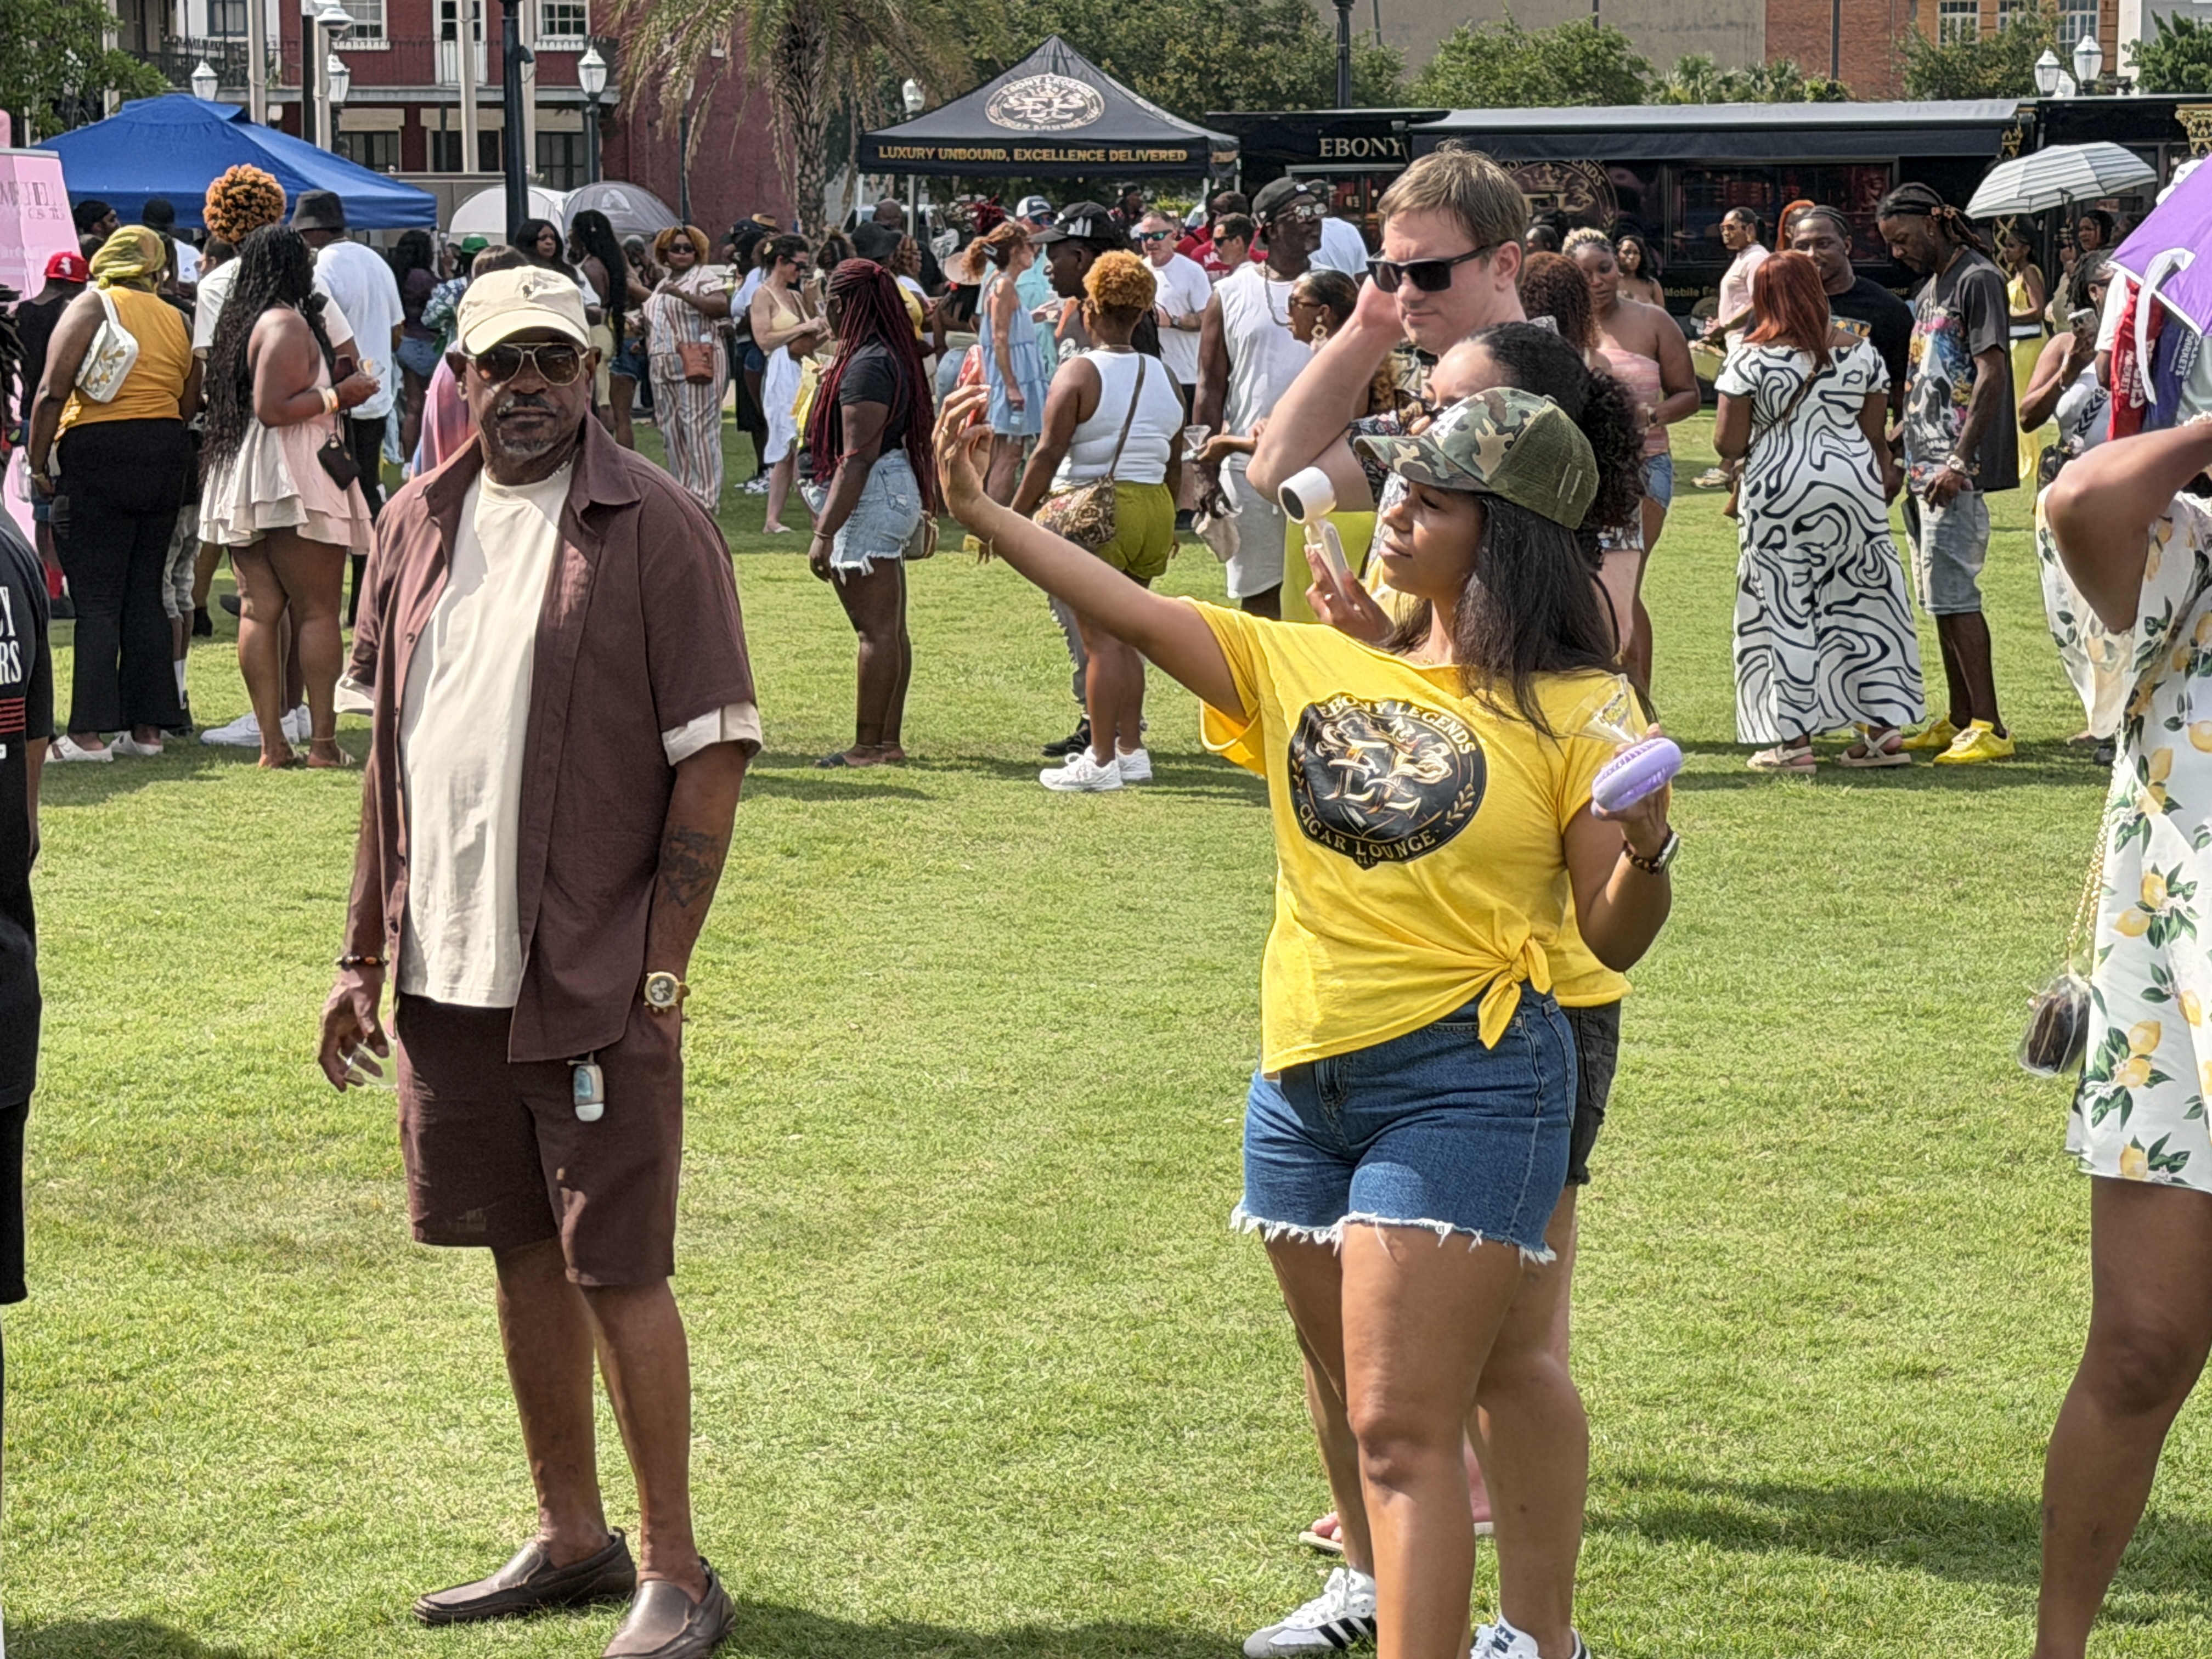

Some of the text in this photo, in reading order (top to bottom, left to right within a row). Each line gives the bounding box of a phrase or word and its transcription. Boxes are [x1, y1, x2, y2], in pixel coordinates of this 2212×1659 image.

[879, 146, 1187, 162] LUXURY UNBOUND, EXCELLENCE DELIVERED
[1319, 138, 1401, 157] EBONY
[1319, 695, 1476, 754] EBONY LEGENDS
[1300, 804, 1436, 859] CIGAR LOUNGE
